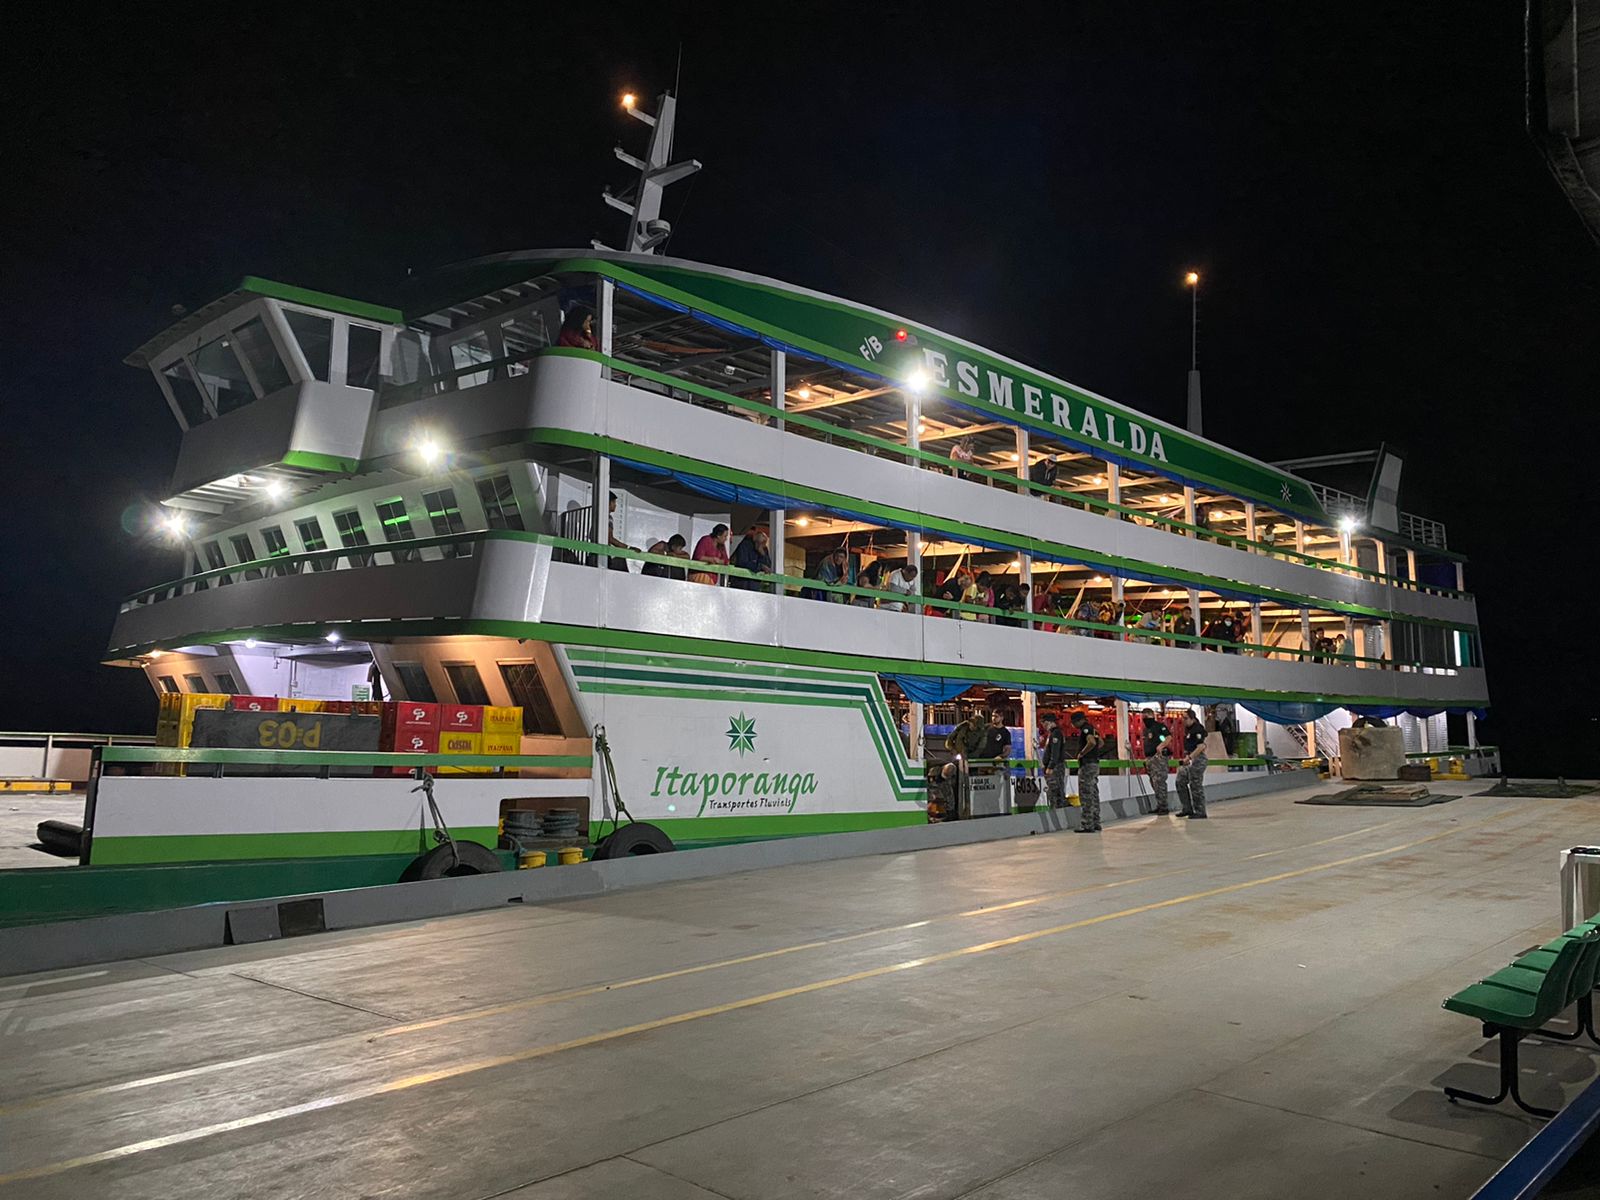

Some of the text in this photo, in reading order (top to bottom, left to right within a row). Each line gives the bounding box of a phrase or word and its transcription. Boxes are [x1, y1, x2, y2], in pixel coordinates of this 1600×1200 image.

[859, 336, 883, 361] F/B
[922, 348, 1168, 463] ESMERALDA
[650, 766, 818, 817] Itaporanga
[709, 799, 758, 812] Transportes
